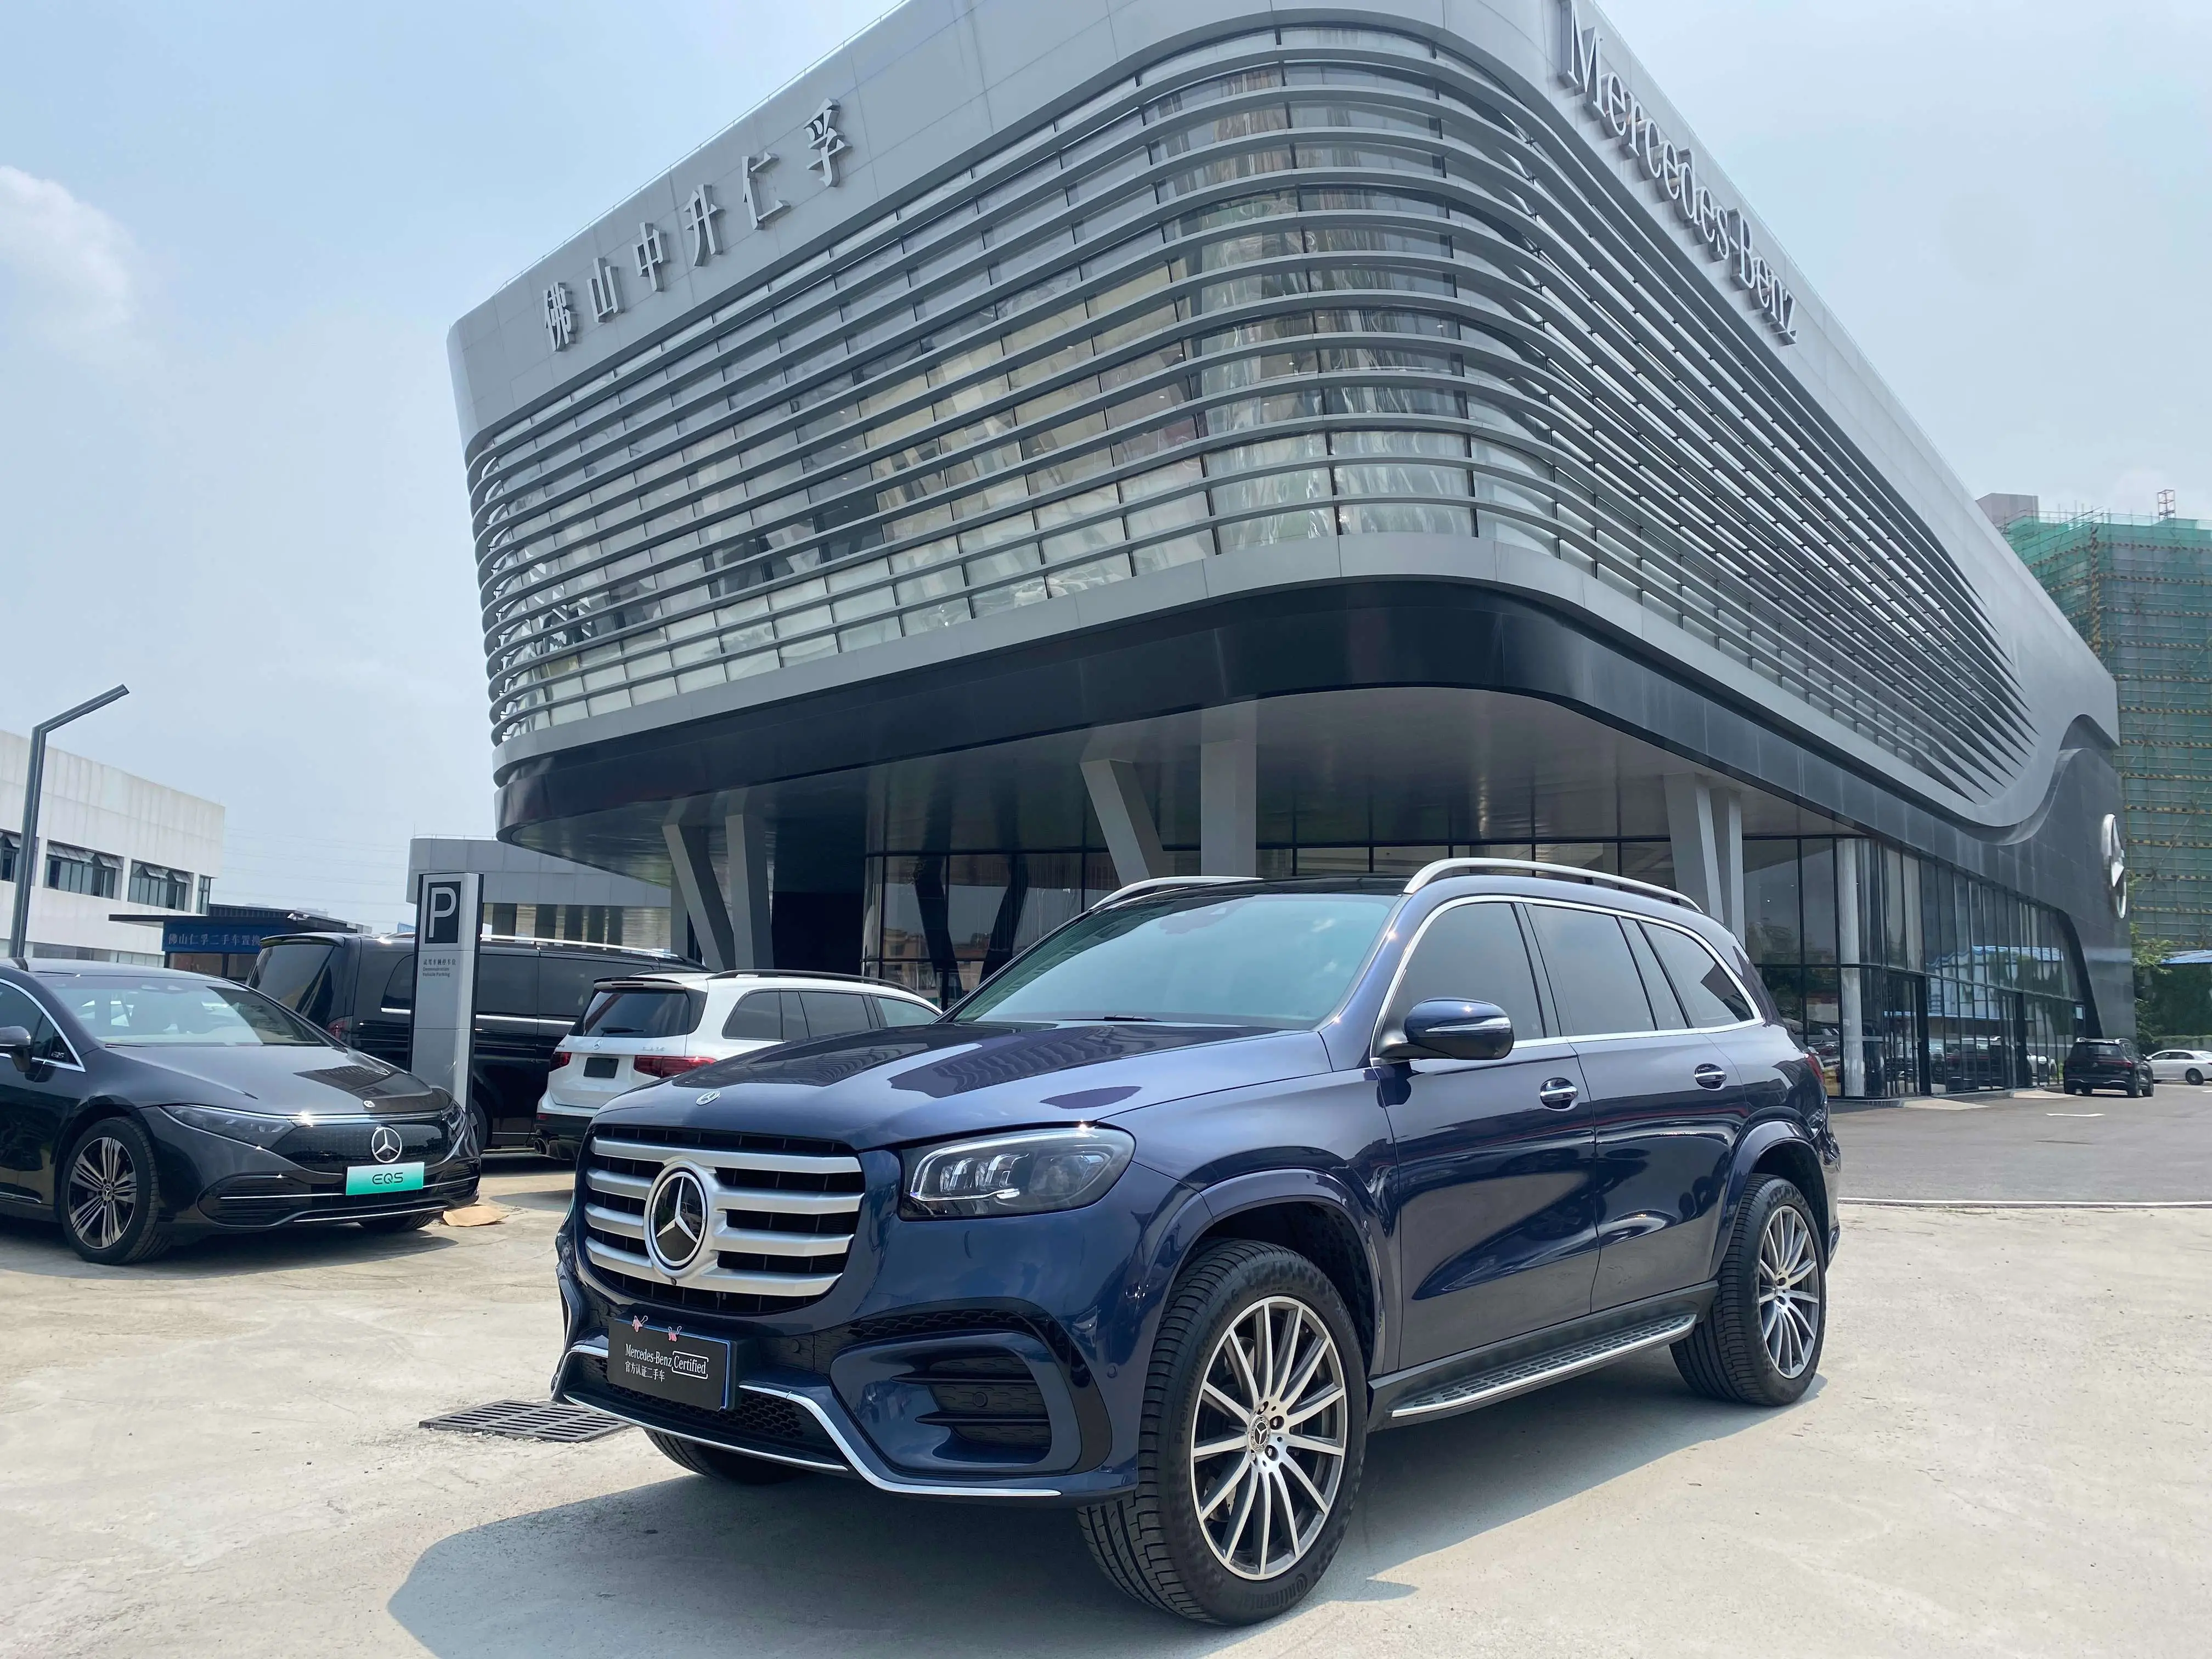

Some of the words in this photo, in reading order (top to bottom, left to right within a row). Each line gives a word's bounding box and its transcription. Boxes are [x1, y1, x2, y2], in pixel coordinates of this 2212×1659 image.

[1559, 0, 1797, 345] Mercedes-Benz
[543, 98, 853, 352] 佛山中升仁孚
[428, 887, 457, 938] P
[372, 1172, 403, 1185] EQS
[625, 1343, 673, 1368] Mercedes-Benz
[674, 1355, 707, 1375] Certified
[625, 1360, 665, 1382] 官方认证二手车
